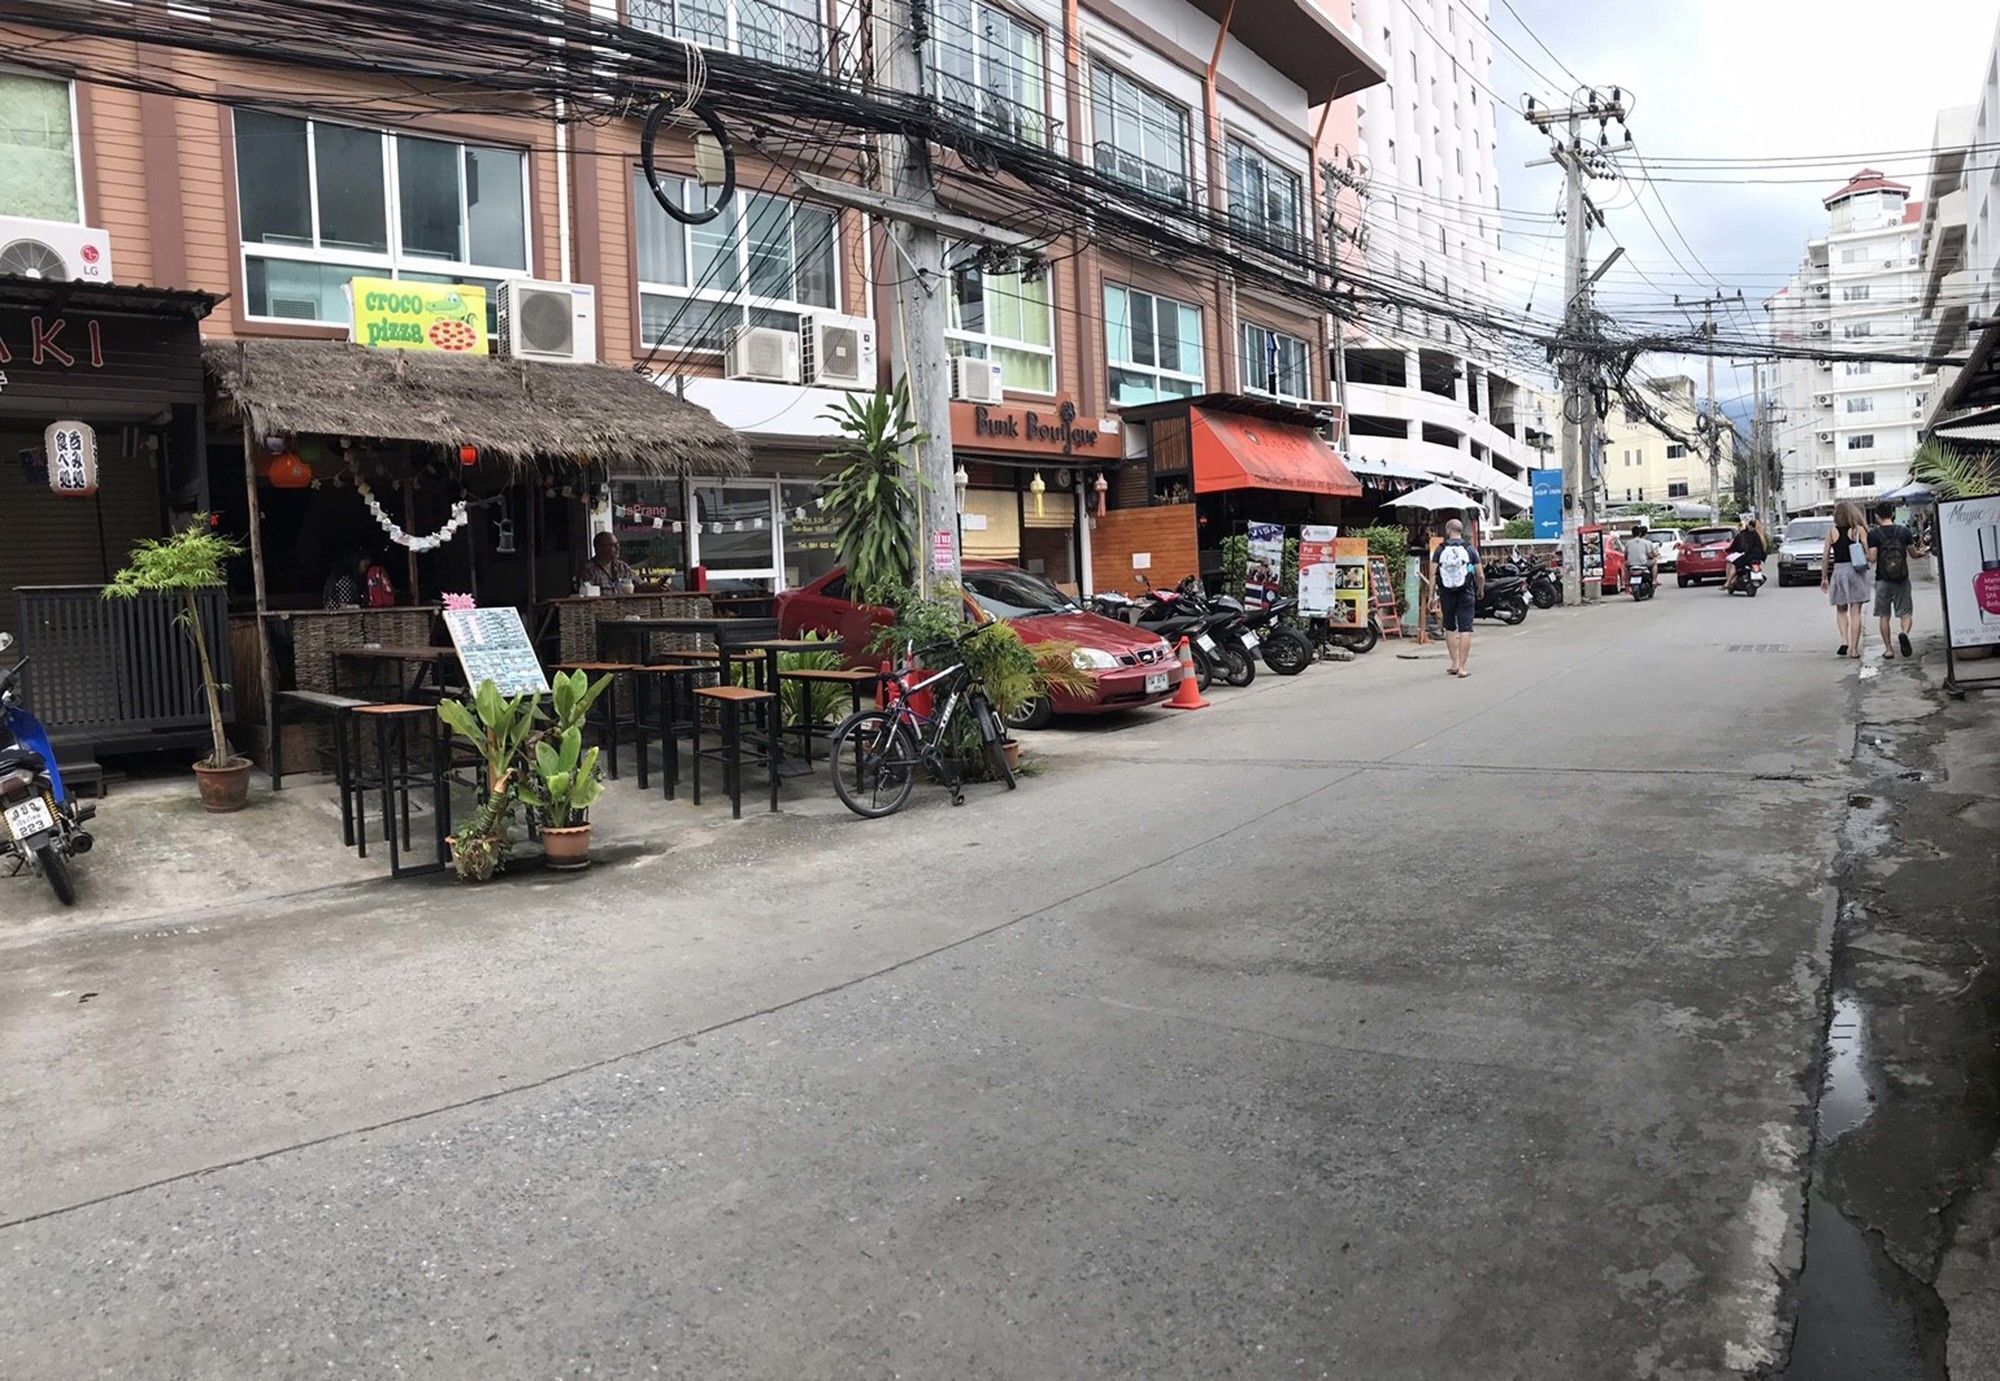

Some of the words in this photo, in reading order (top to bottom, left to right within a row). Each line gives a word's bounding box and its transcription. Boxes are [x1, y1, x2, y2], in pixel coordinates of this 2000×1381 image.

[83, 266, 98, 276] LG
[365, 291, 423, 315] croco
[367, 317, 424, 347] pizza
[974, 405, 1019, 438] Bunk
[19, 820, 45, 837] 223
